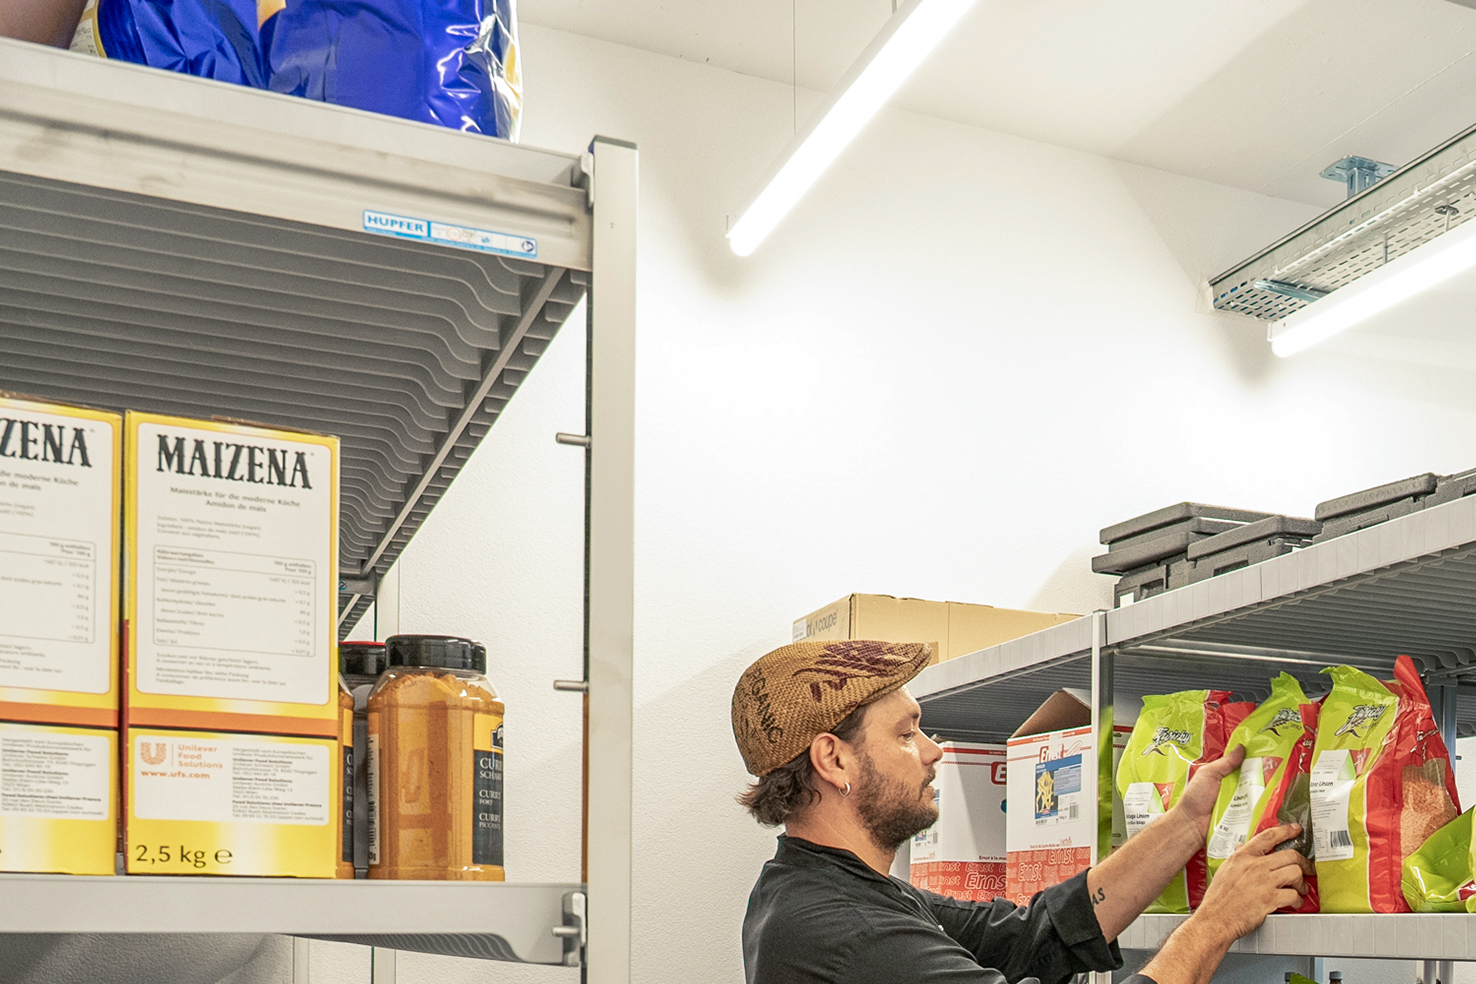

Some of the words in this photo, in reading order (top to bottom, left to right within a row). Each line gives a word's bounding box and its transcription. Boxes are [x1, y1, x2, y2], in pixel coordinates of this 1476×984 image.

[367, 215, 424, 232] HUPFER
[156, 434, 312, 489] MAIZENA
[14, 473, 51, 482] moderne
[170, 486, 213, 497] Maisstärke
[243, 495, 275, 504] moderne
[277, 499, 300, 507] Küche
[206, 500, 235, 509] Amidon
[178, 761, 223, 769] Solutions
[141, 771, 210, 779] www.ufs.com
[136, 845, 171, 865] 2,5
[180, 845, 206, 868] kg
[964, 871, 1006, 890] Erns
